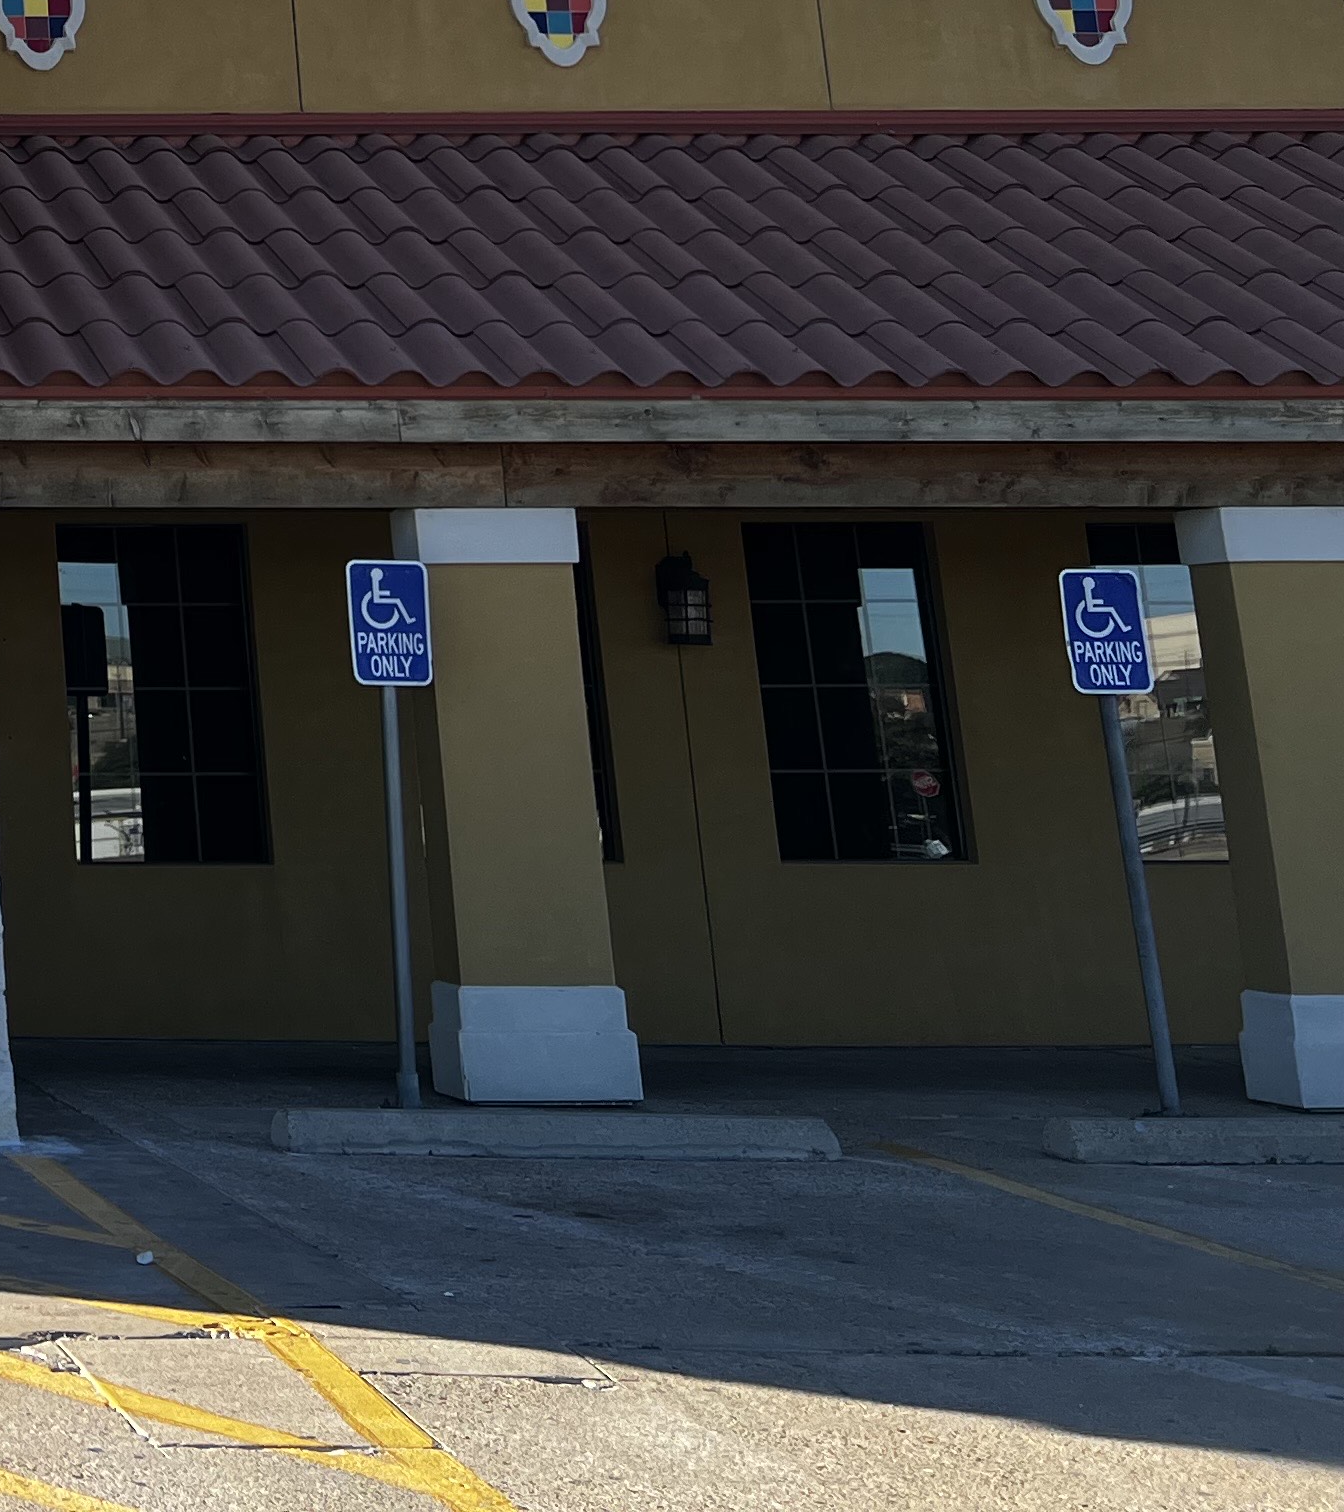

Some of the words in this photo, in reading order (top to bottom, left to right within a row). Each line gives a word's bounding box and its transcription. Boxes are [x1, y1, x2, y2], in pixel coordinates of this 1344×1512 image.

[357, 632, 424, 655] PARKING
[1073, 641, 1143, 663] PARKING
[371, 655, 412, 677] ONLY
[1090, 664, 1132, 686] ONLY
